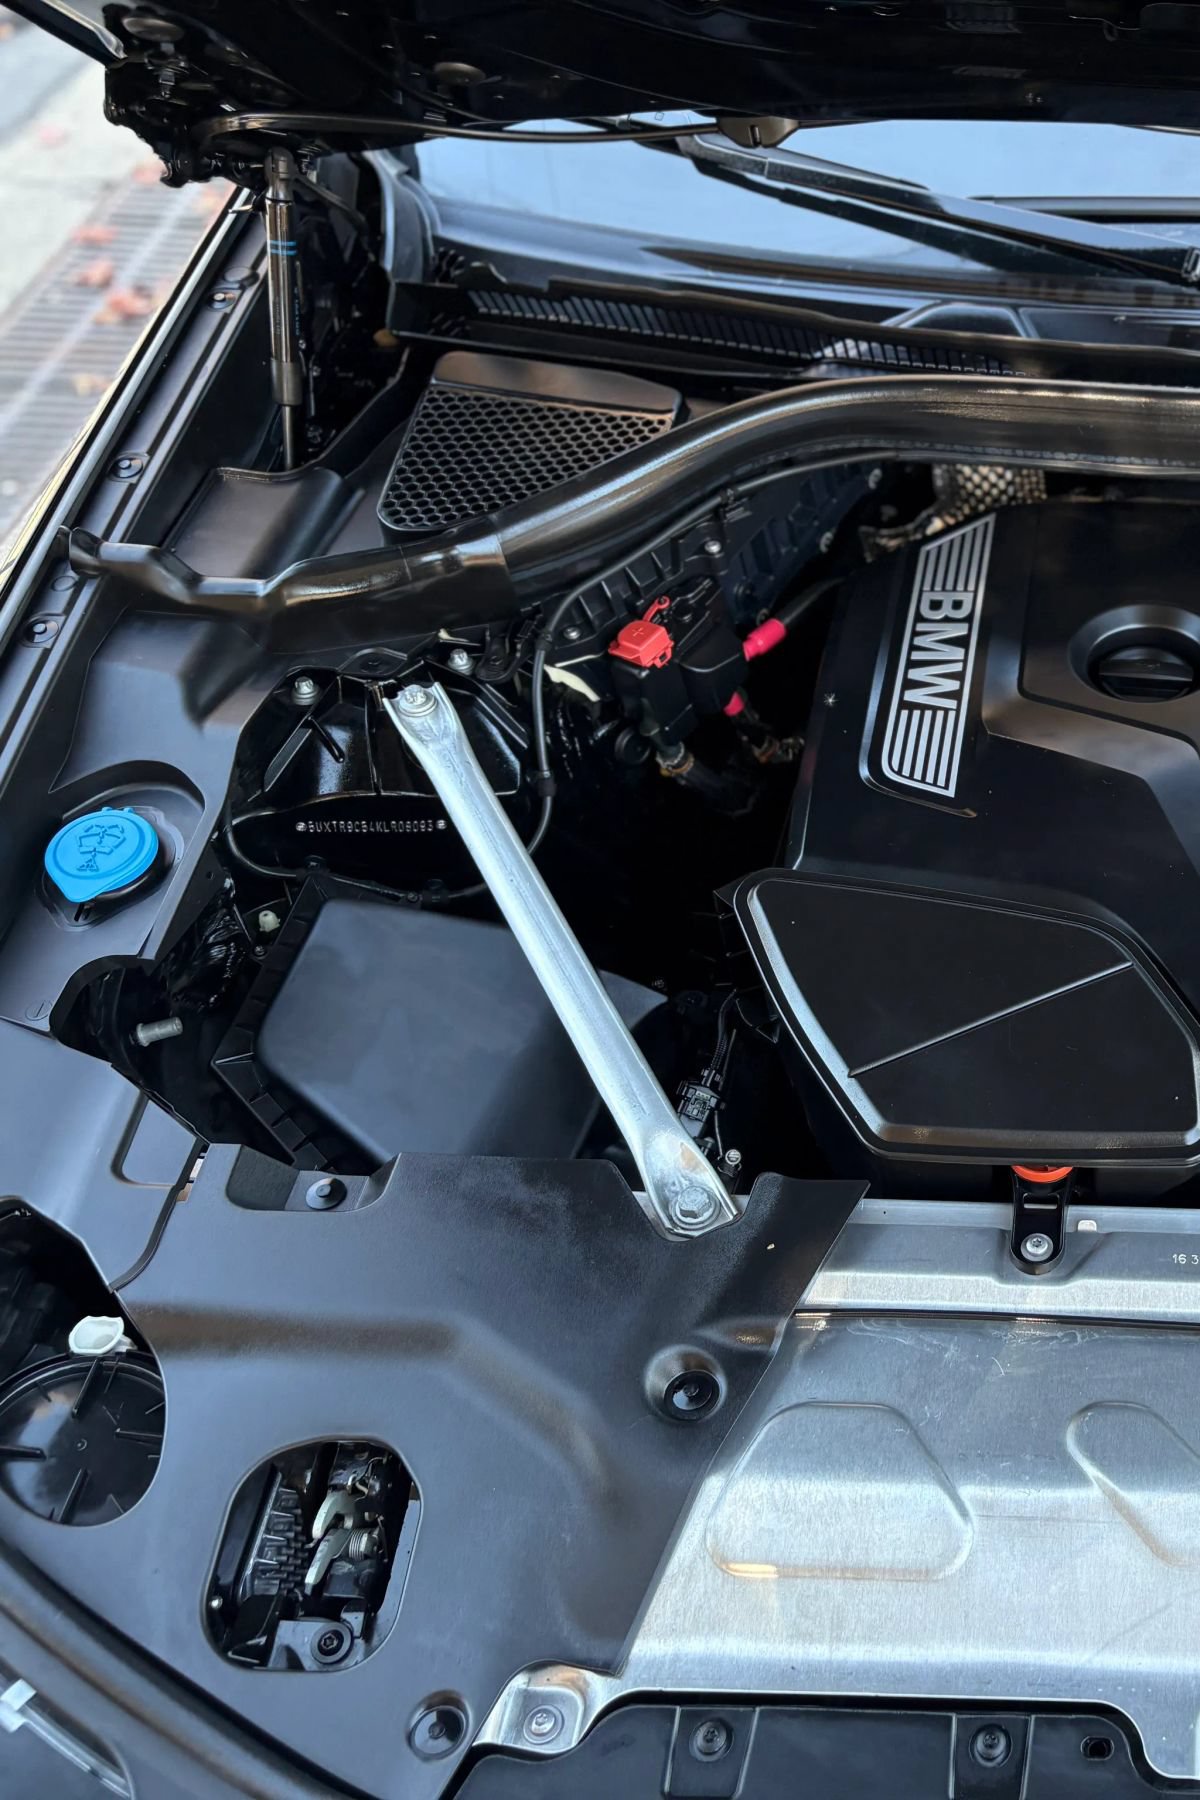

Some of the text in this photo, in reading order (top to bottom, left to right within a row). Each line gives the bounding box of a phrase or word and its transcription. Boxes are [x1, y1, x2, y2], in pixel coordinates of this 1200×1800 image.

[903, 591, 975, 710] BMW
[1172, 1253, 1200, 1265] 16 3
